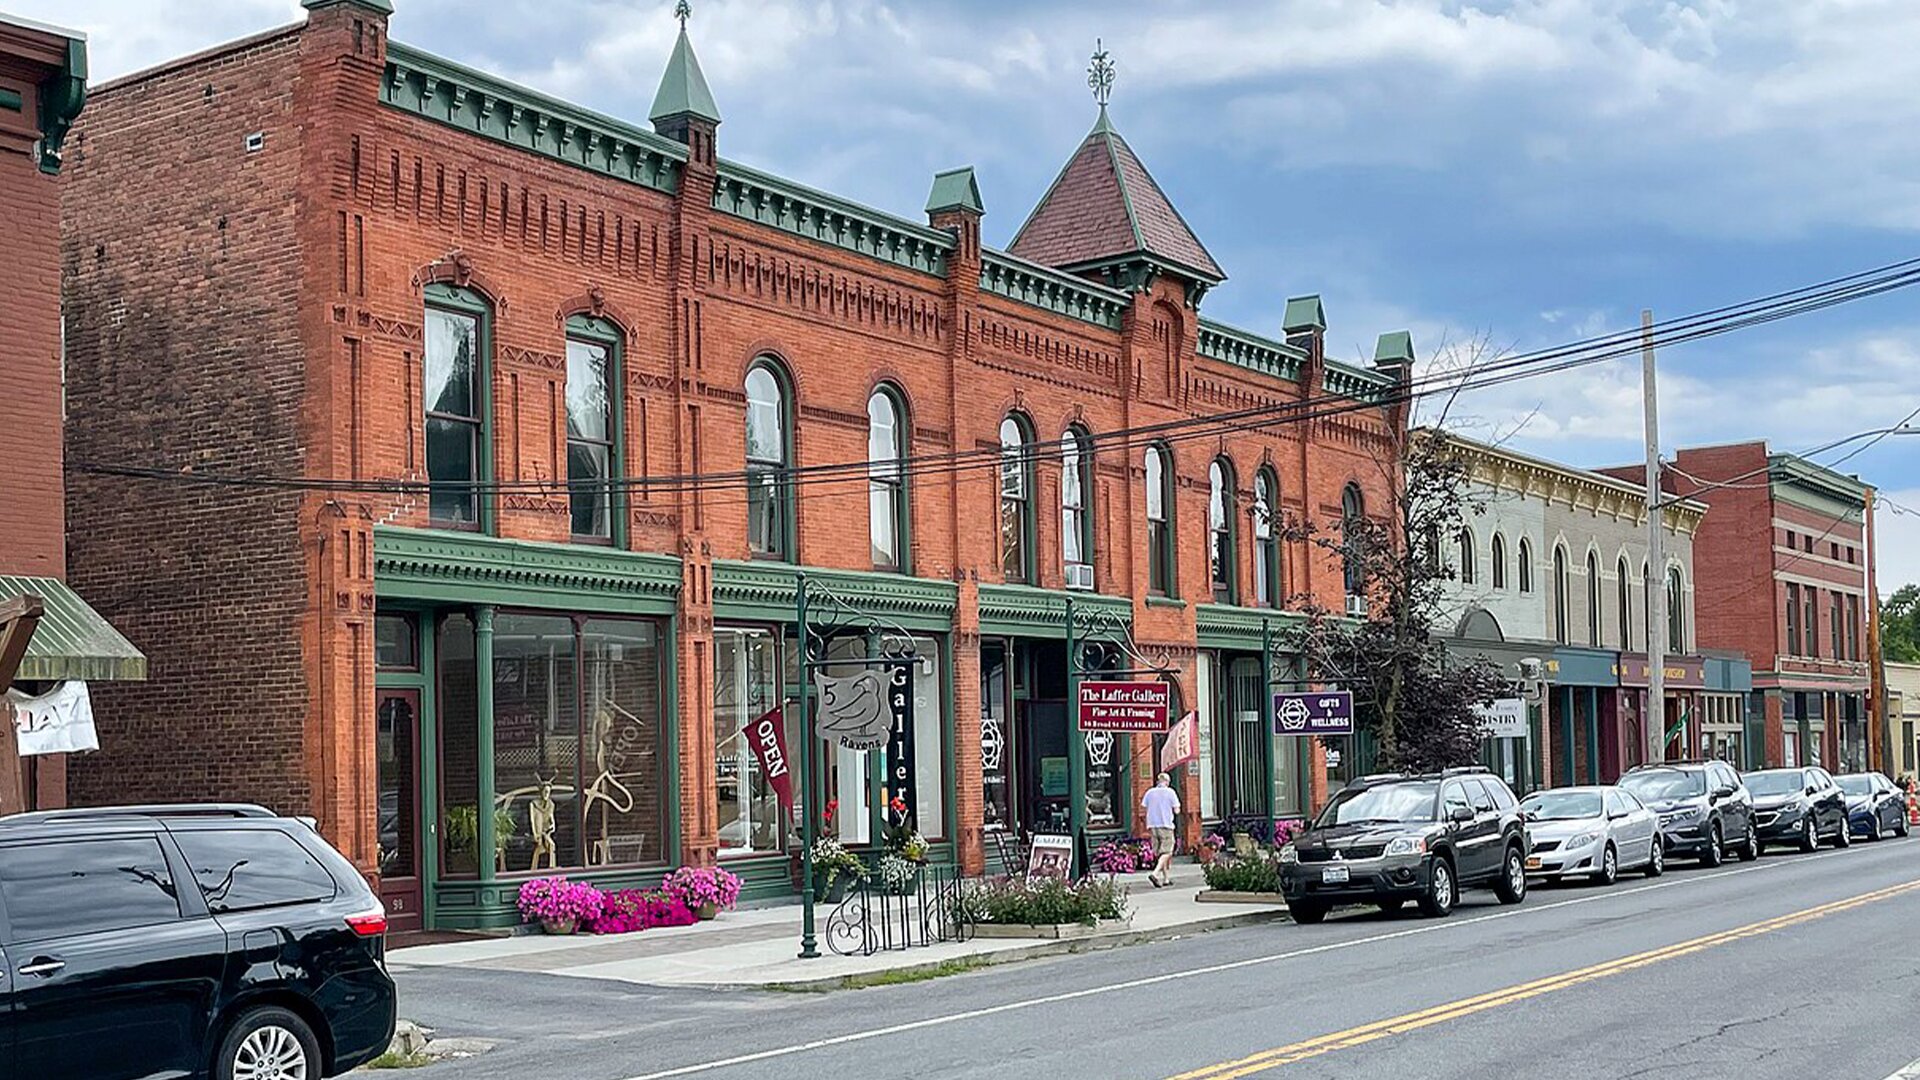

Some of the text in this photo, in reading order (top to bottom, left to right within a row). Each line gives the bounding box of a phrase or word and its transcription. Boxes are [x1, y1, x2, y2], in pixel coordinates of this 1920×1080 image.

[823, 682, 838, 706] 5
[1081, 689, 1166, 706] The Laffer Gallery
[1318, 698, 1340, 708] GIFTS
[1092, 707, 1155, 718] Fine Art & Framing
[1311, 717, 1349, 728] WELLNESS
[757, 720, 788, 778] OPEN
[839, 736, 881, 751] Ravens
[890, 666, 910, 826] Gallery
